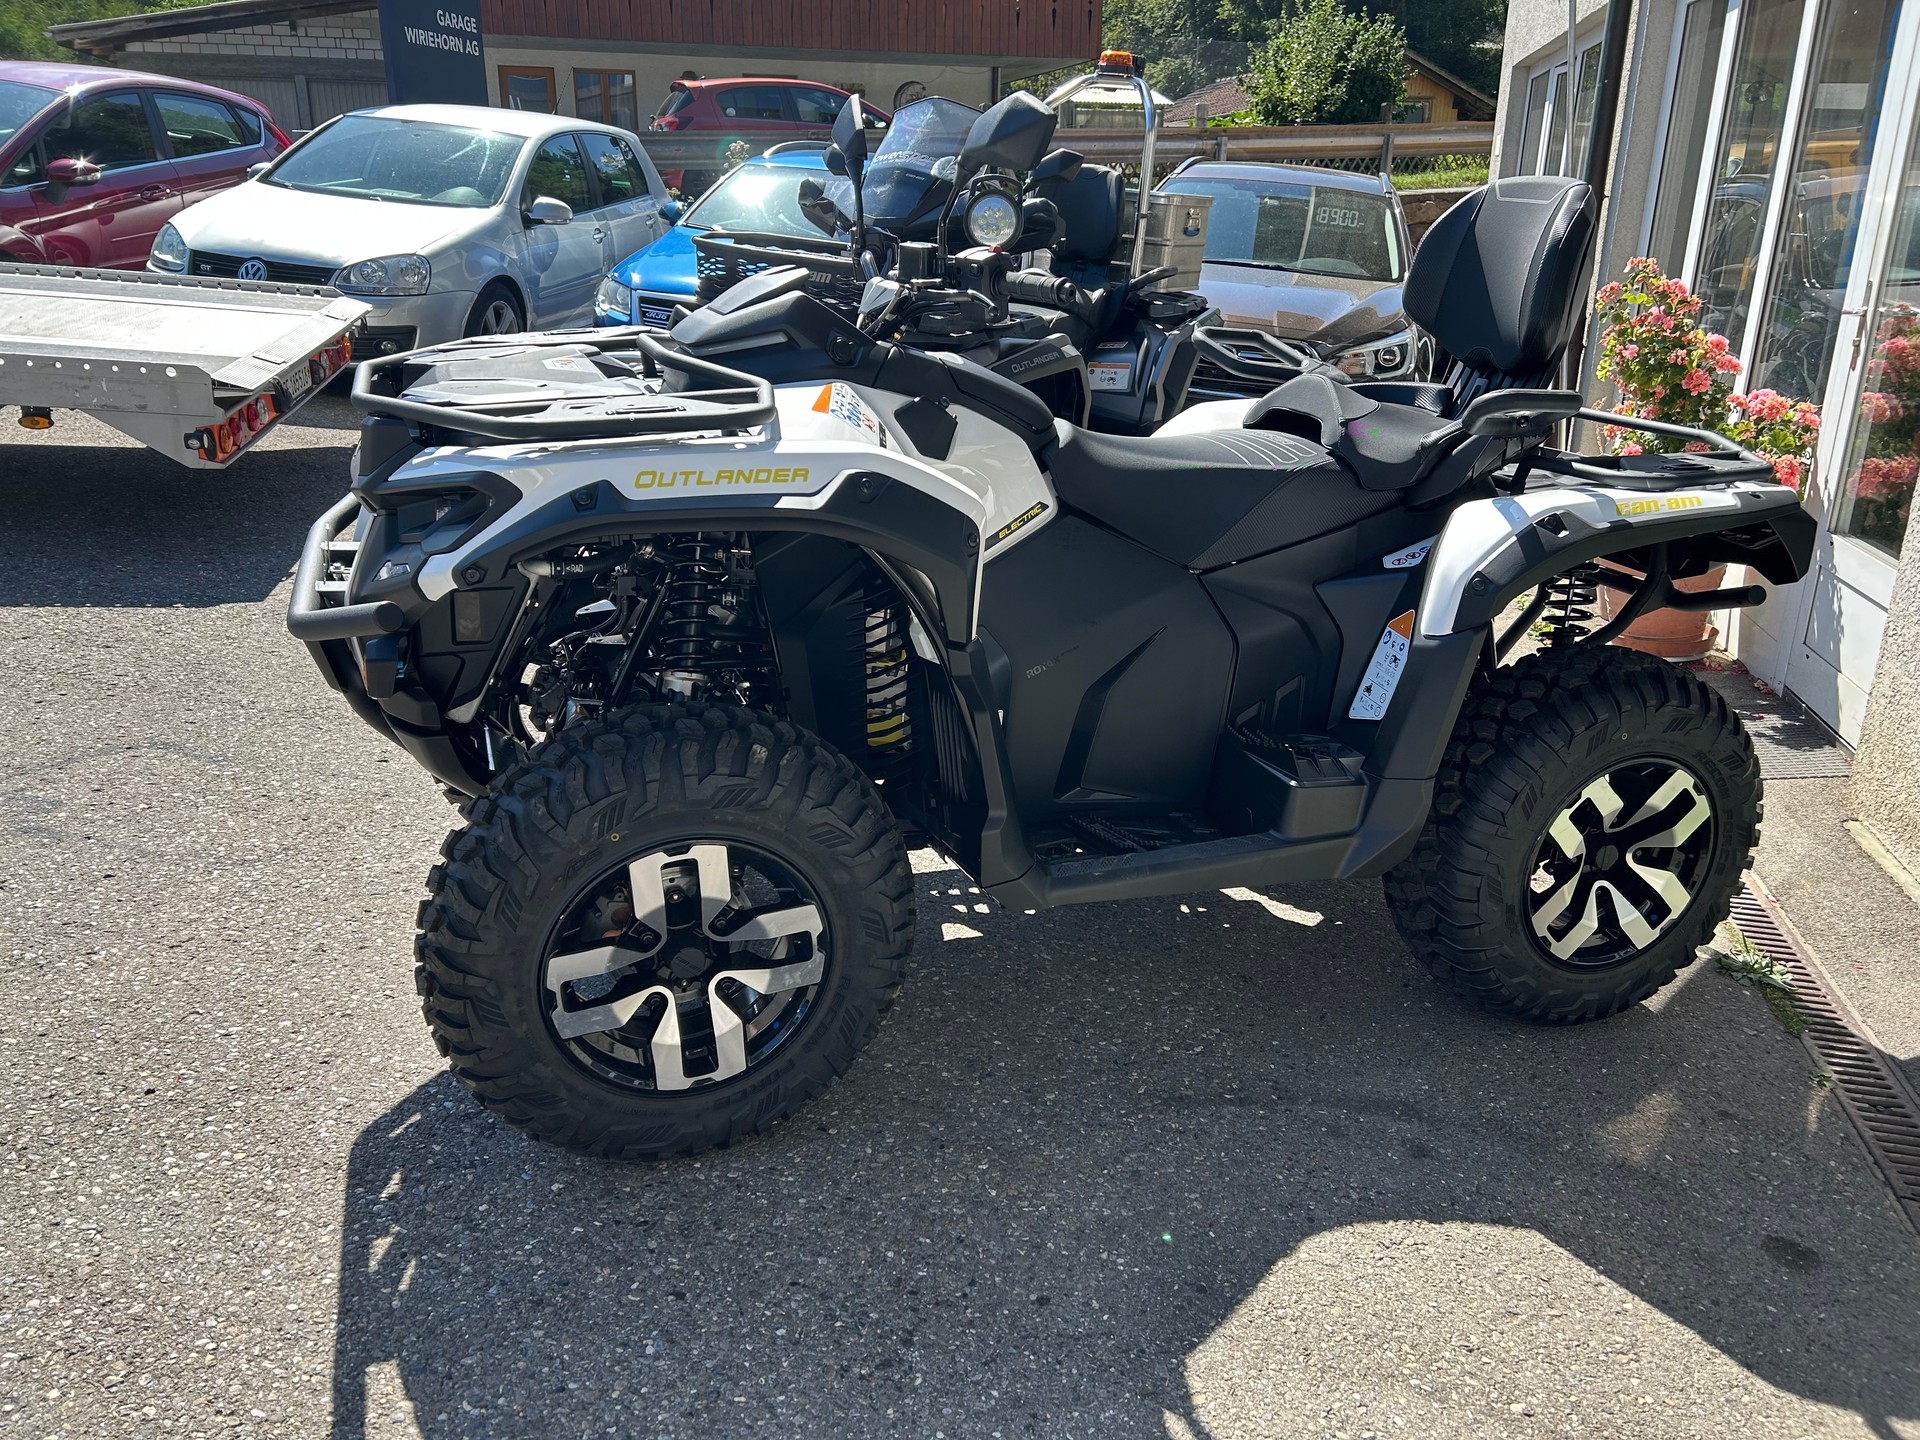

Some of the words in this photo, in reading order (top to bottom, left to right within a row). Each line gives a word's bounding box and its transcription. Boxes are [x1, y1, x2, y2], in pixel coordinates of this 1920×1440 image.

[436, 9, 477, 33] GARAGE
[404, 26, 463, 53] WIRIEHORN
[465, 39, 479, 56] AG
[1011, 351, 1060, 373] OUTLANDER
[634, 468, 810, 489] OUTLANDER
[1616, 495, 1703, 517] can-am
[999, 504, 1042, 539] ELECTRIC
